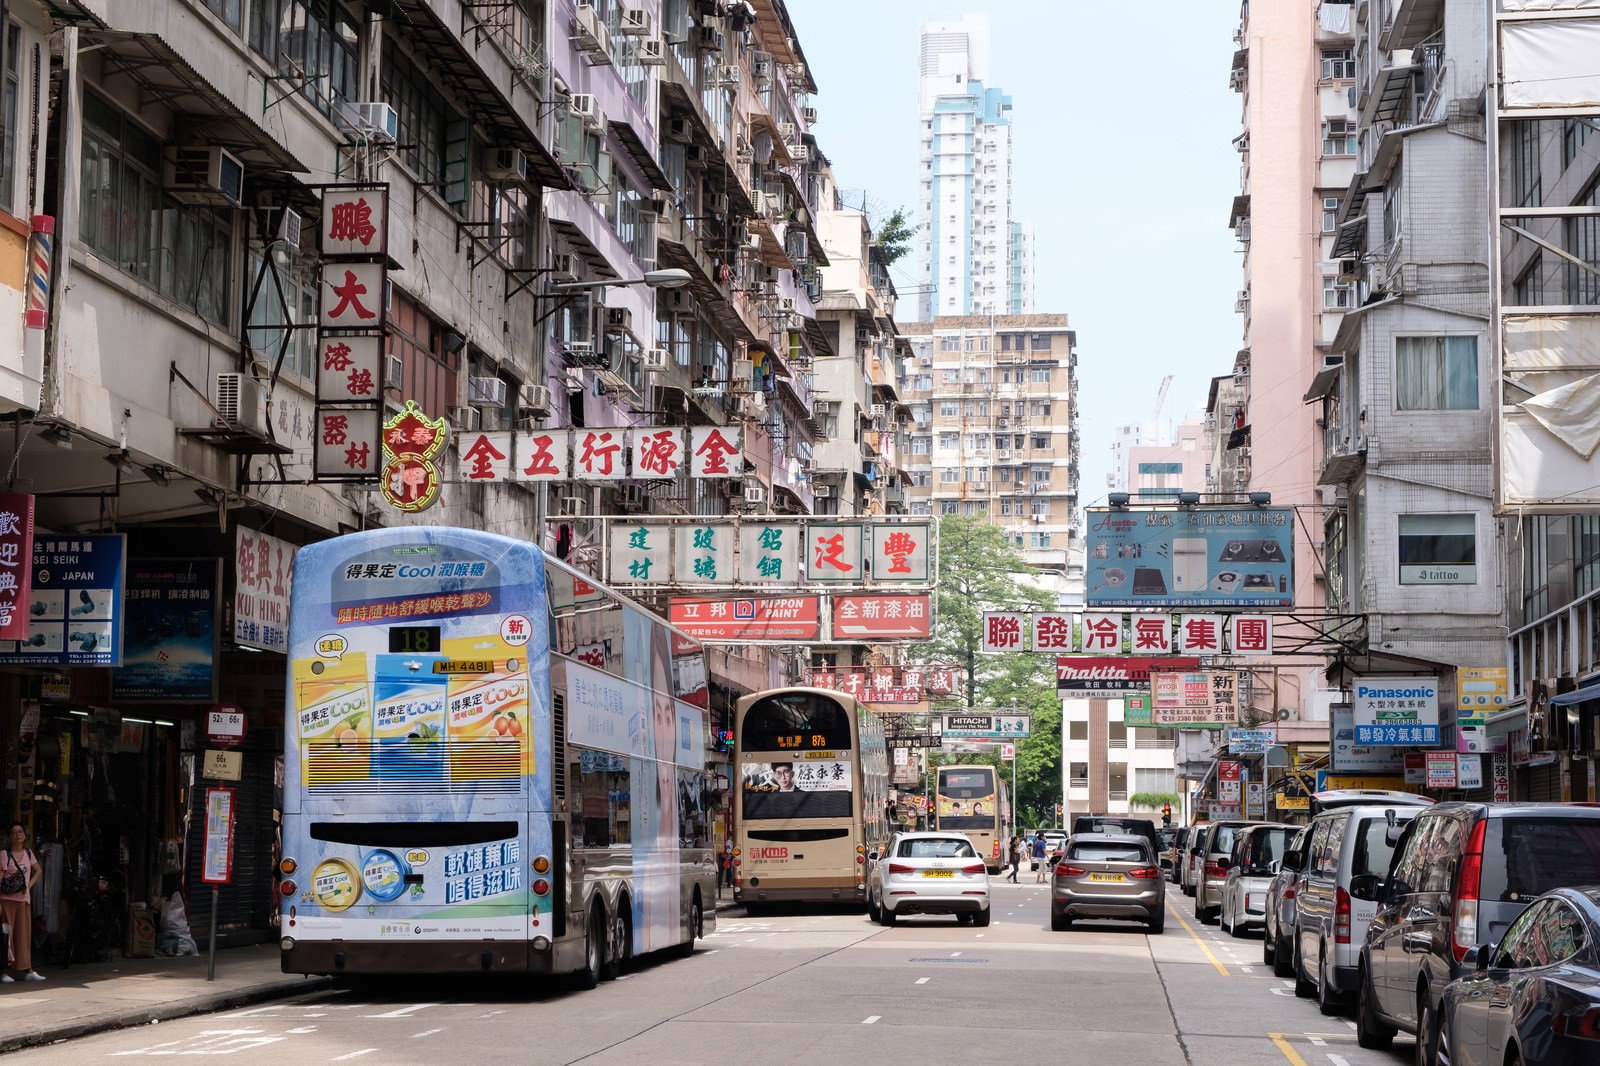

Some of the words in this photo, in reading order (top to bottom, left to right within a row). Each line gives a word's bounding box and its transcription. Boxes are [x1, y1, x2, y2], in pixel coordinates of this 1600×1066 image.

[53, 555, 79, 564] SEIKI
[239, 533, 295, 597] 鉅興五
[62, 571, 94, 581] JAPAN
[346, 562, 396, 579] 得果定
[397, 563, 437, 578] Cool
[438, 561, 486, 578] 潤喉糖
[1430, 571, 1459, 580] tattoo
[237, 593, 254, 617] KUI
[260, 600, 281, 623] HING
[761, 599, 804, 609] NIPPON
[840, 599, 924, 619] 全新漆油
[765, 609, 799, 618] PAINT
[508, 619, 524, 634] 新
[987, 616, 1268, 651] 聯發冷氣集團
[402, 629, 430, 648] 18
[440, 661, 457, 672] MH
[461, 661, 488, 672] 4481
[1358, 686, 1434, 698] Panasonic
[451, 693, 483, 713] 得果定
[1367, 700, 1426, 709] 大型冷氣系統
[301, 706, 329, 727] 得果定
[377, 705, 406, 719] 得果定
[953, 717, 987, 725] HITACHI
[812, 735, 826, 747] 87B
[1359, 728, 1436, 742] 聯發冷氣集團
[445, 840, 520, 877] 軟硬兼備
[762, 847, 788, 858] KMB
